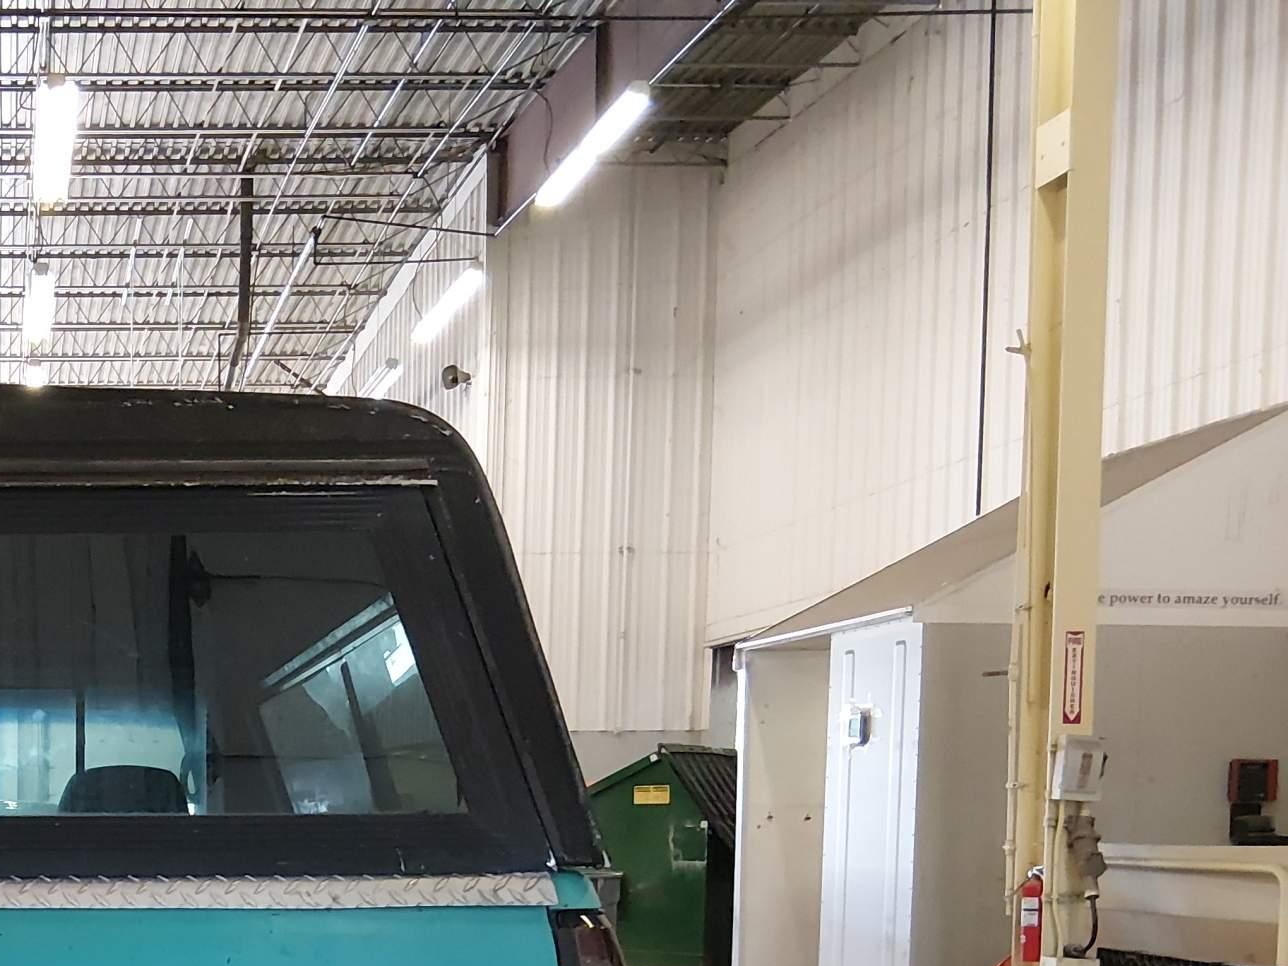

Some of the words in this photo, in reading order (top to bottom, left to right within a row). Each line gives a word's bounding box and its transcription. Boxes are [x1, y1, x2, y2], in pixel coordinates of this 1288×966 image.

[1110, 593, 1154, 607] power
[1157, 593, 1171, 605] to
[1174, 594, 1218, 606] amaze
